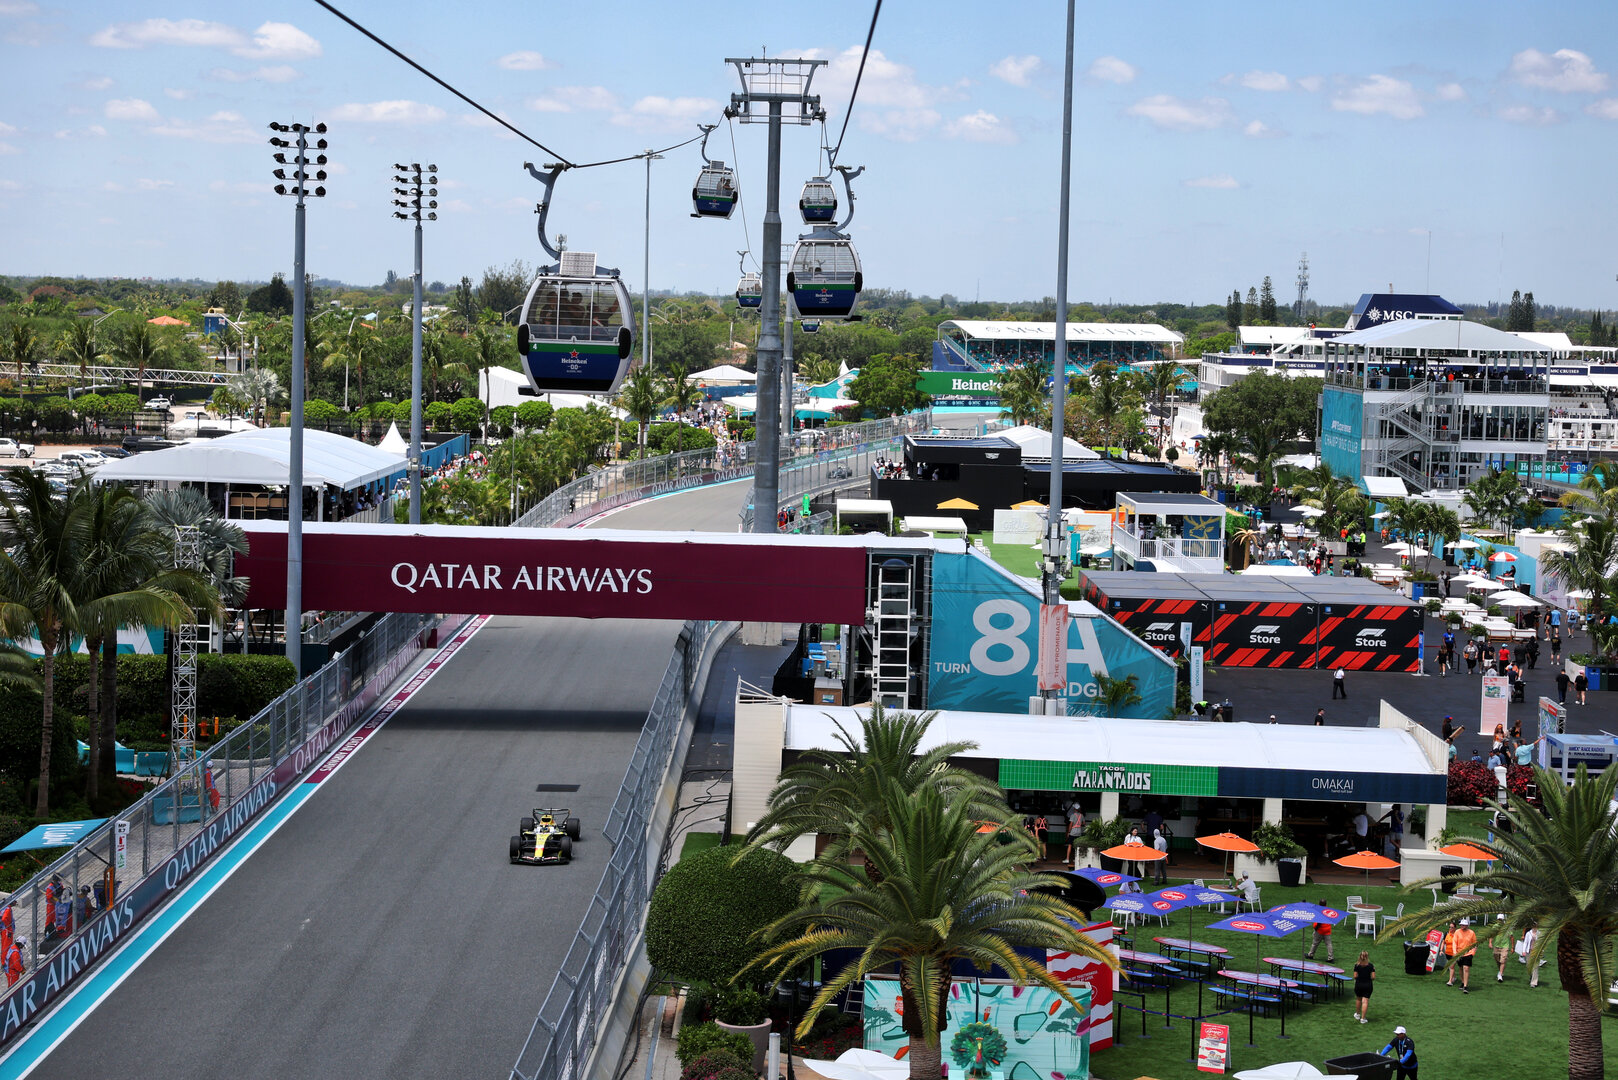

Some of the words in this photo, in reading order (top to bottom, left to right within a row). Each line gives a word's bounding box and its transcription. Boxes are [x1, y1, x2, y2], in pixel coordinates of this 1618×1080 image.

[1382, 310, 1413, 321] MSC
[714, 468, 737, 483] QATAR
[738, 465, 756, 477] AIRW
[652, 482, 673, 496] QATAR
[674, 476, 704, 492] AIRWAYS
[390, 562, 503, 594] QATAR
[511, 565, 653, 594] AIRWAYS
[1144, 632, 1176, 641] Store
[1249, 635, 1281, 644] Store
[1355, 637, 1387, 647] Store
[934, 661, 971, 674] TURN
[375, 663, 396, 697] QATAR
[294, 727, 329, 774] QATAR
[331, 697, 365, 742] AIRWAYS
[1072, 770, 1151, 791] ATARANTADOS
[1311, 777, 1354, 790] OMAKAI
[165, 823, 218, 890] QATAR
[221, 772, 276, 843] AIRWAYS
[44, 895, 134, 1003] AIRWAYS
